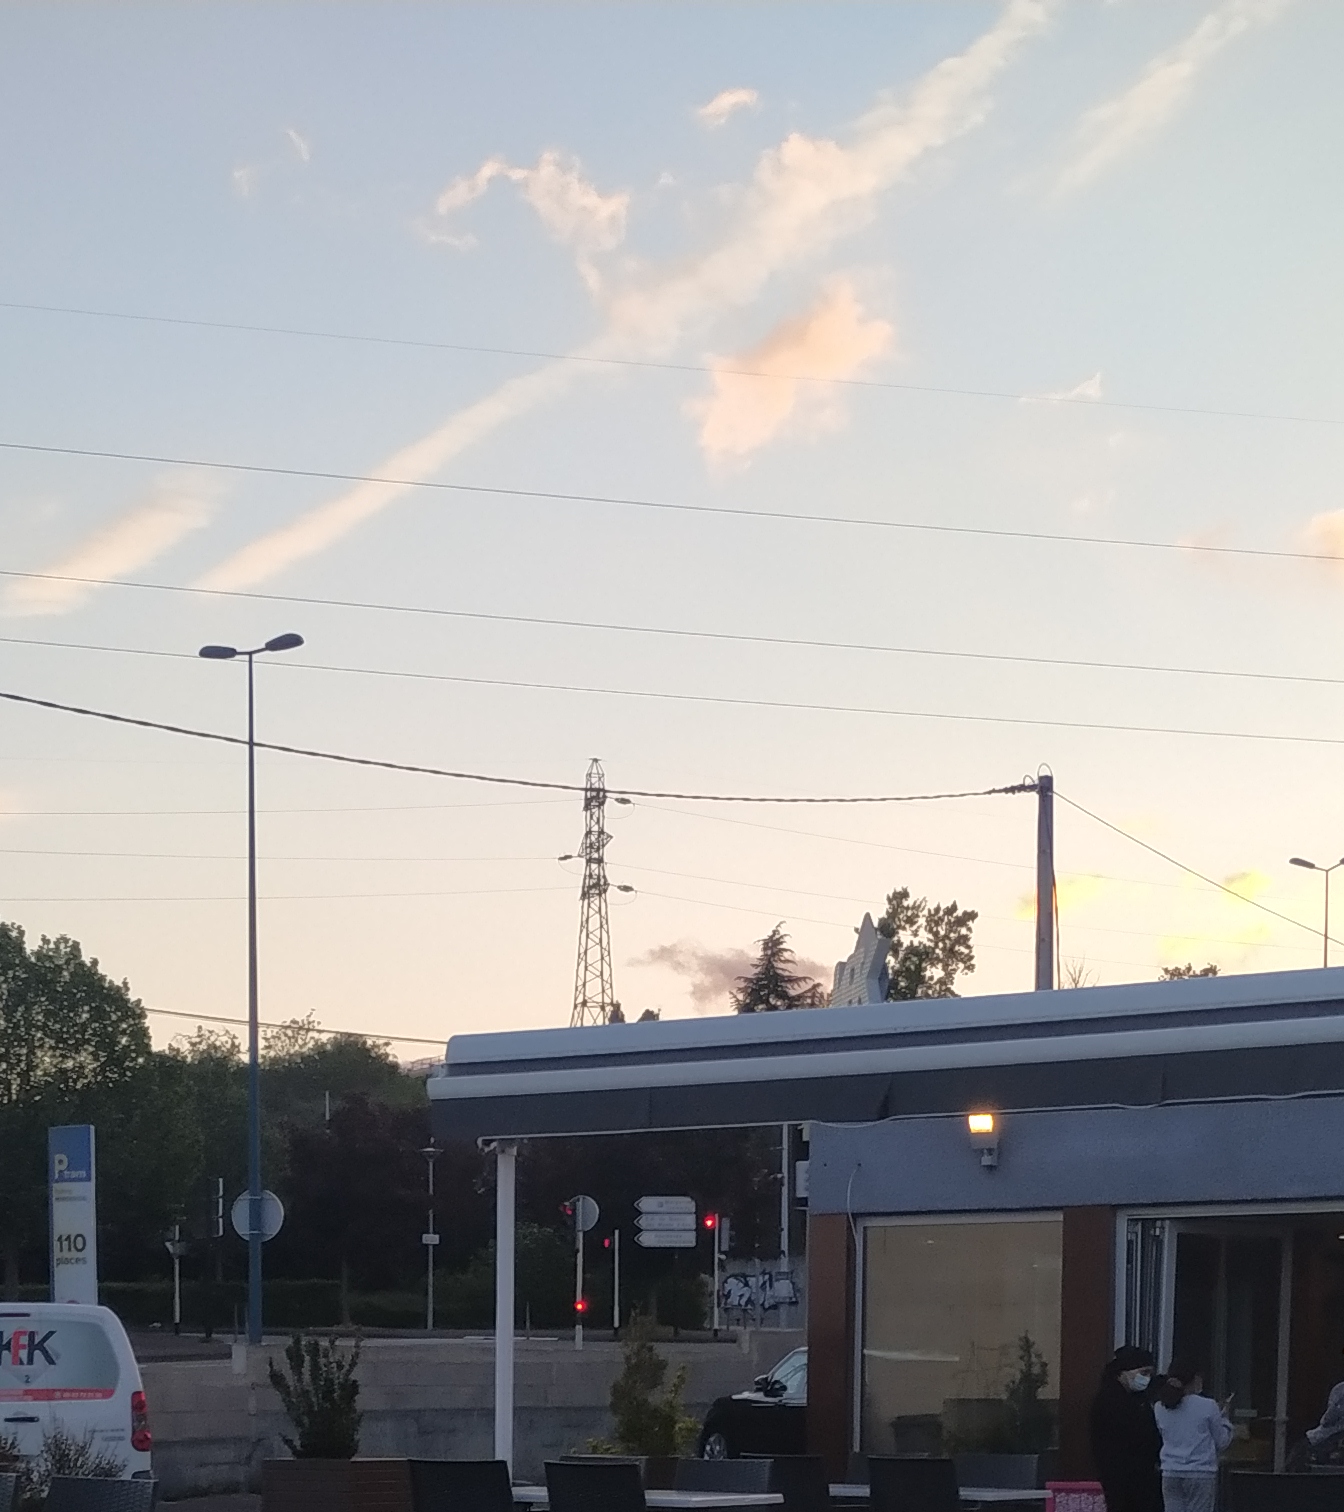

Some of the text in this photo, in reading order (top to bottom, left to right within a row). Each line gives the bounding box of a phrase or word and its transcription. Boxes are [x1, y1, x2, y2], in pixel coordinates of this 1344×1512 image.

[54, 1153, 69, 1180] P
[56, 1233, 87, 1253] 110
[55, 1255, 88, 1267] places
